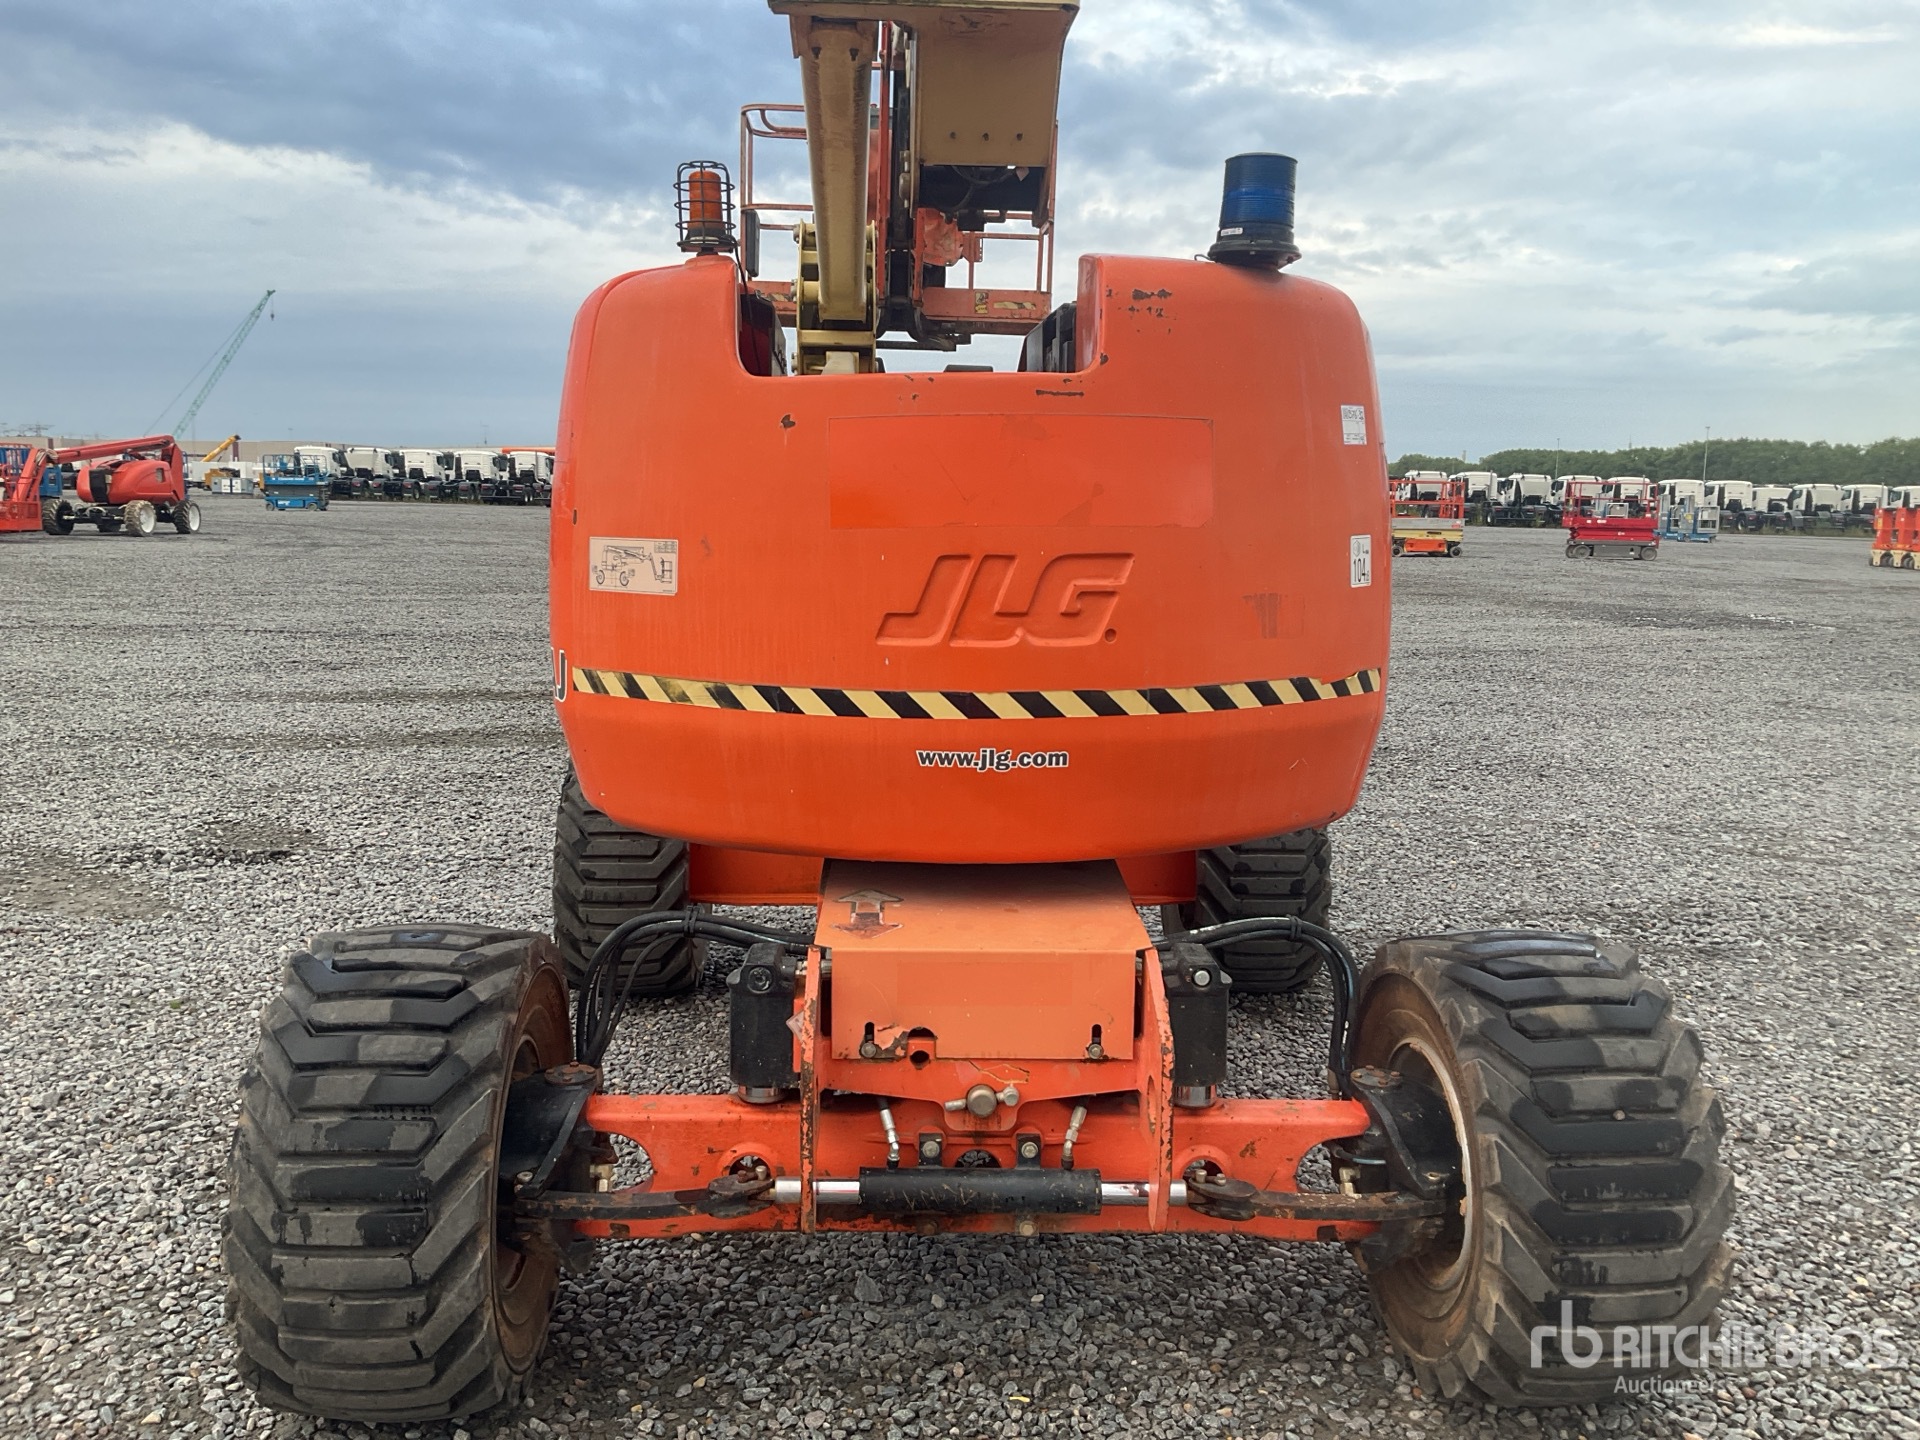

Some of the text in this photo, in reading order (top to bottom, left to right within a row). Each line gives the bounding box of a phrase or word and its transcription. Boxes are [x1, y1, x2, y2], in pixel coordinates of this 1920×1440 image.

[1353, 557, 1366, 583] 104
[876, 553, 1135, 647] JLG
[916, 747, 1070, 773] www.jlg.com
